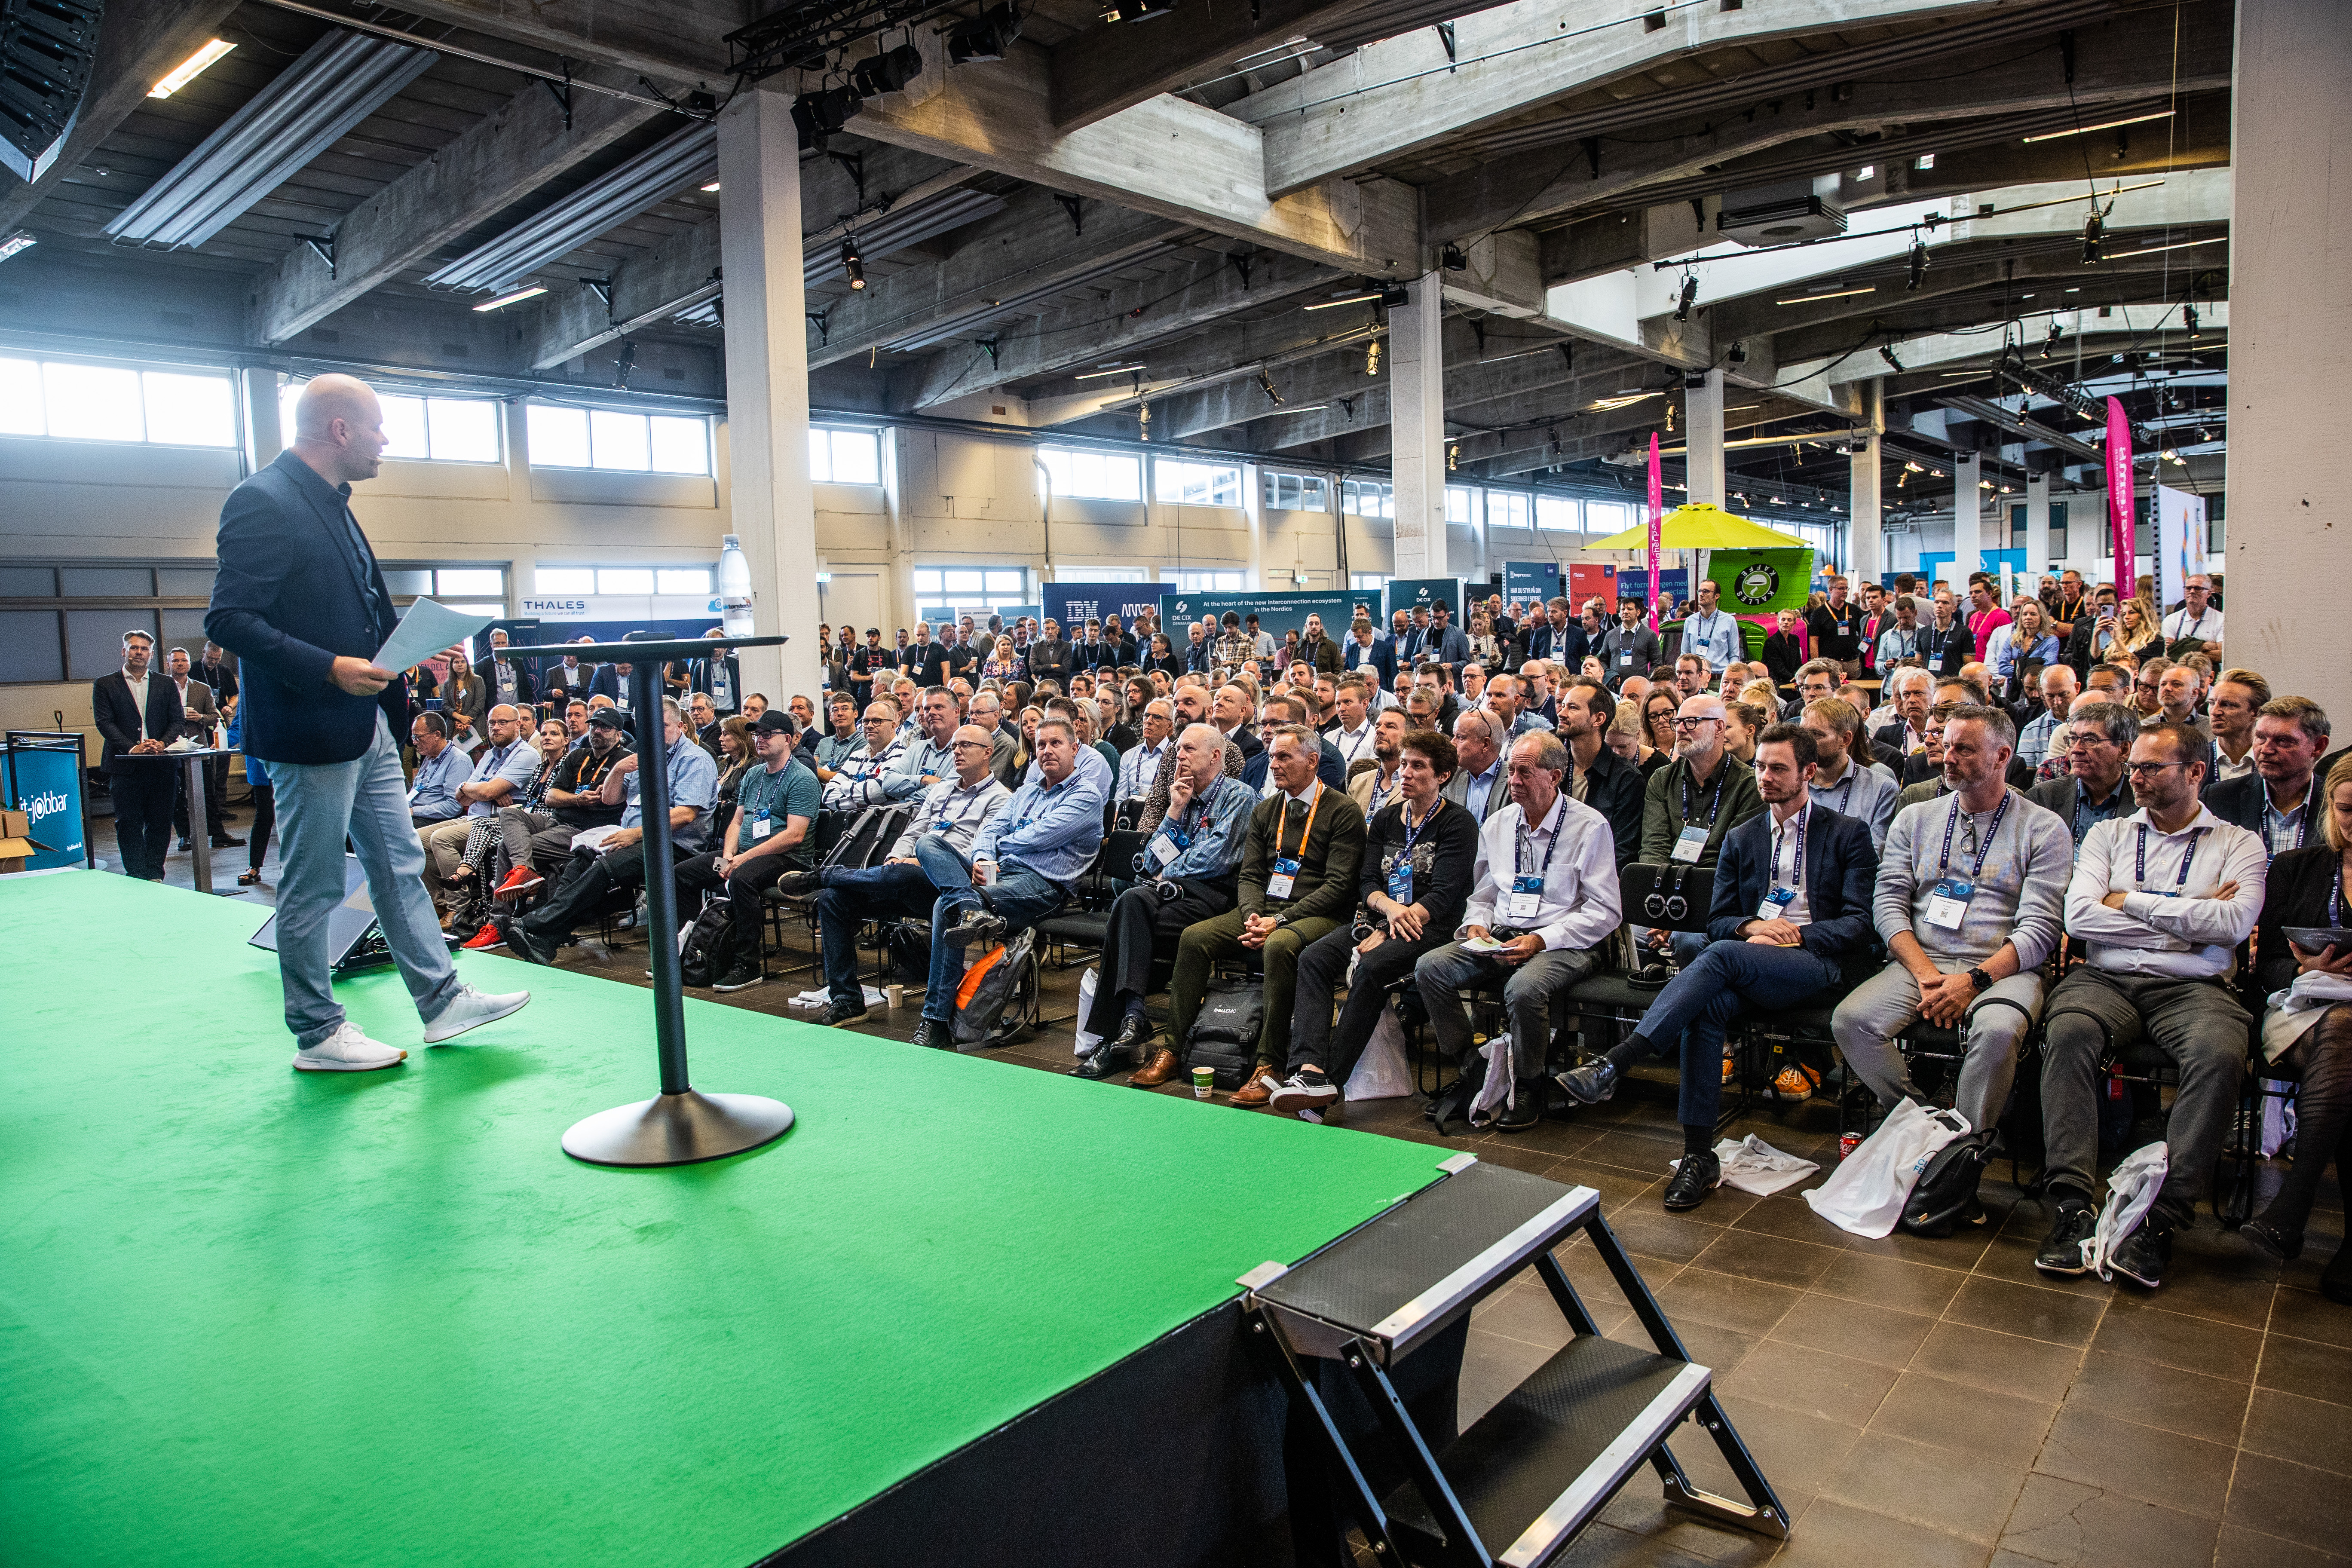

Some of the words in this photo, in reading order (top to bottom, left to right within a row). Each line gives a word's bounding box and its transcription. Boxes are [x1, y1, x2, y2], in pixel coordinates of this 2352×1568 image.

[1741, 564, 1776, 577] KAFFE
[524, 601, 584, 609] THALES
[1736, 591, 1775, 605] KALLES
[1066, 601, 1099, 622] IBM
[1193, 818, 1203, 833] THALES
[1202, 802, 1211, 816] THALES
[1210, 786, 1219, 800] THALES
[1427, 800, 1439, 817] THALES
[1415, 818, 1428, 834] THALES
[1556, 812, 1564, 830] THALES
[1977, 843, 1988, 864] THALES
[1986, 821, 1998, 841] THALES
[1996, 798, 2008, 818] THALES
[1404, 835, 1416, 851] THALES
[1549, 832, 1558, 851] THALES
[2185, 842, 2194, 863] THALES
